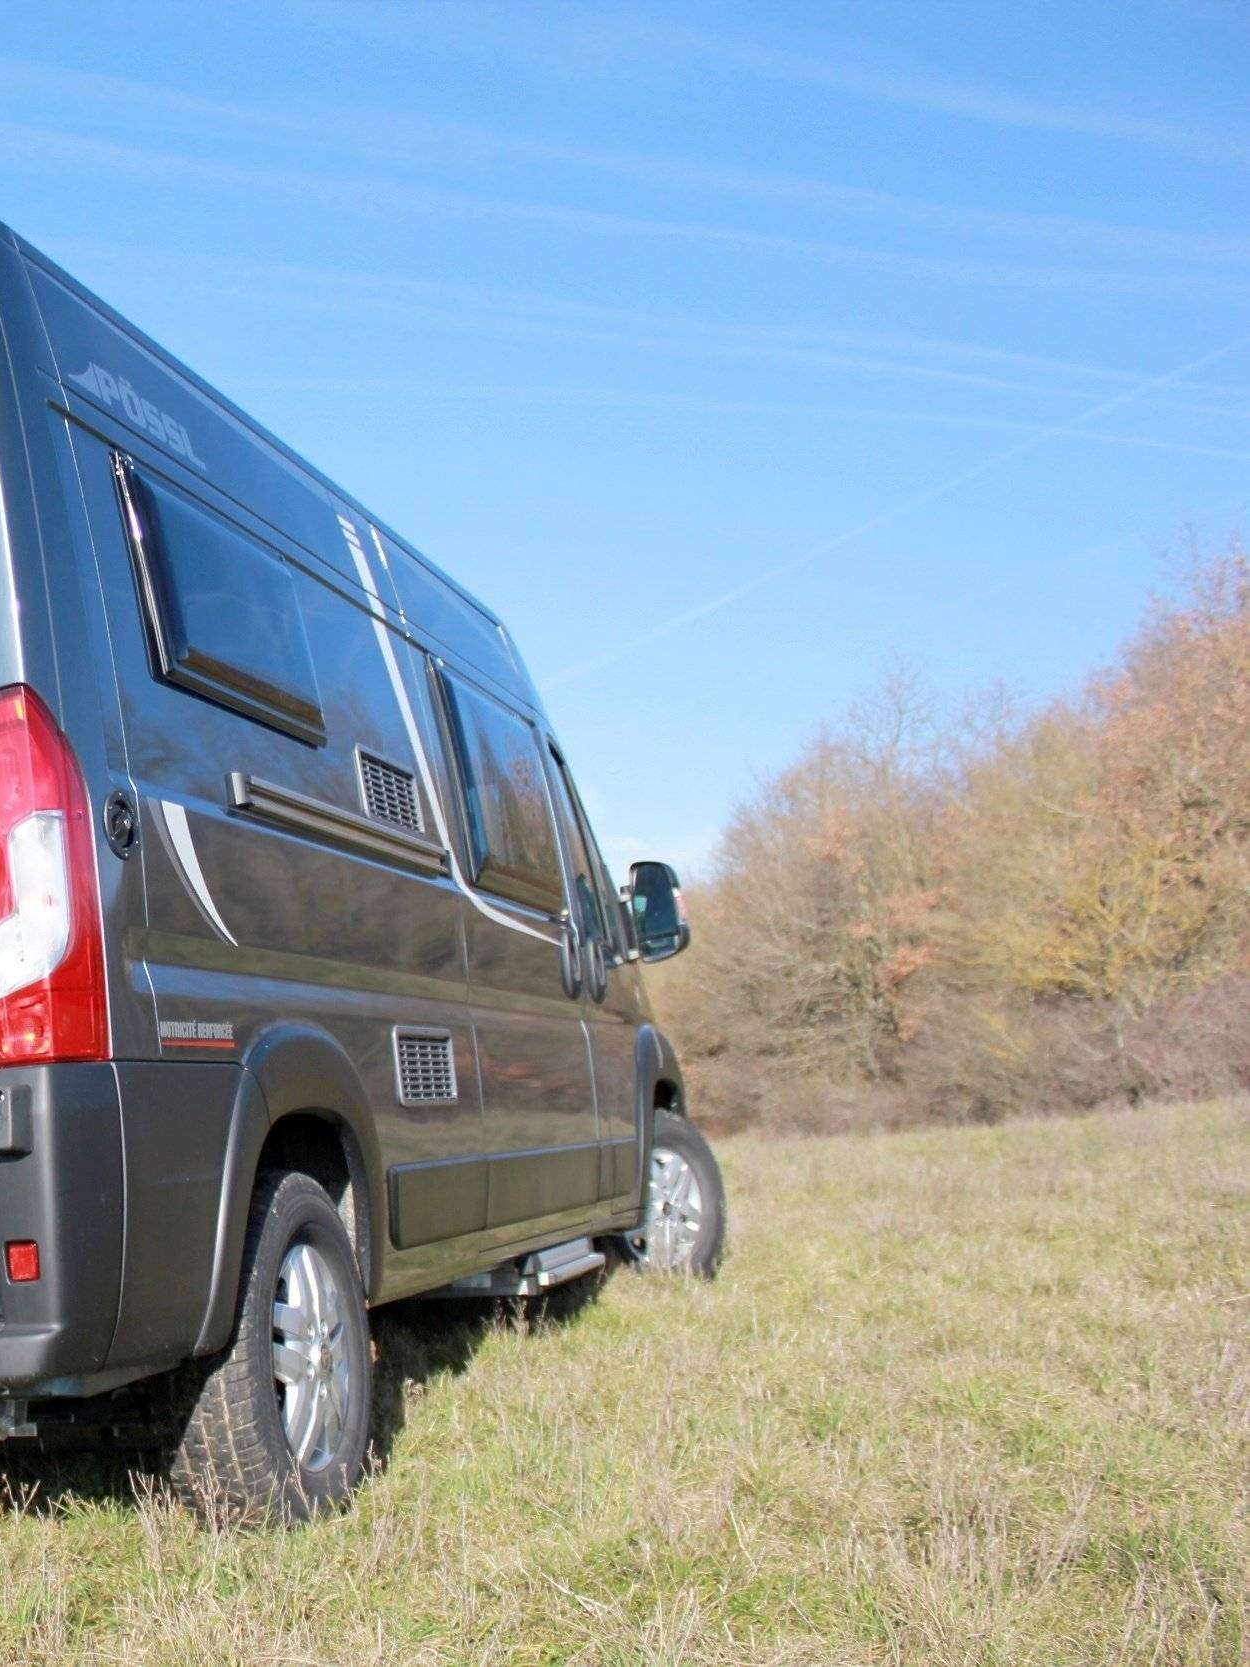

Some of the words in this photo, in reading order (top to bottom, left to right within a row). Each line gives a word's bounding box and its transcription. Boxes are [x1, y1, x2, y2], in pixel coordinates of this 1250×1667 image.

[93, 363, 206, 470] PÖSSL
[160, 1019, 197, 1038] MOTRICITÉ
[198, 1021, 234, 1039] RENFORCÉE
